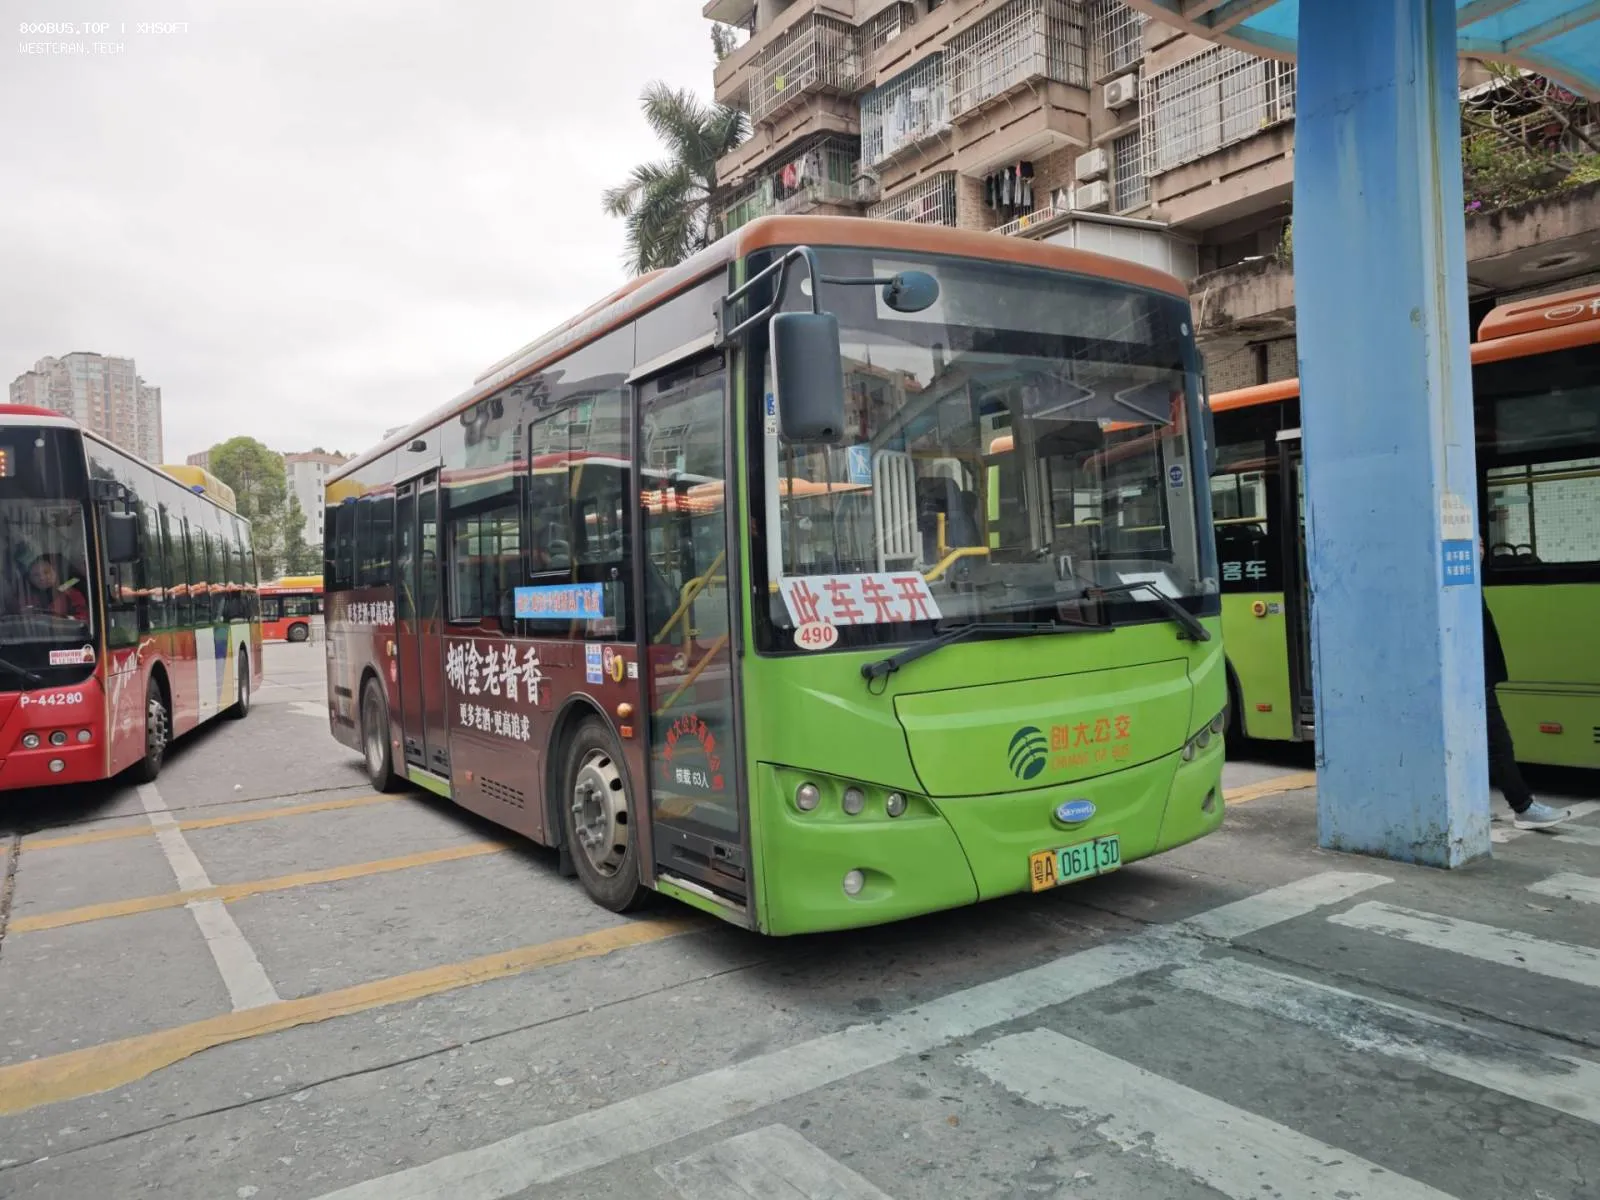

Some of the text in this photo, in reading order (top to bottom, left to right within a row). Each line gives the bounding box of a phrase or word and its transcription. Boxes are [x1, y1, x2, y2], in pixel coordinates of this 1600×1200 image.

[1223, 560, 1267, 581] 客车
[789, 576, 930, 624] 此车先开
[801, 626, 833, 644] 490
[20, 691, 83, 708] P-44280
[1033, 838, 1120, 884] 粤A 06113D
